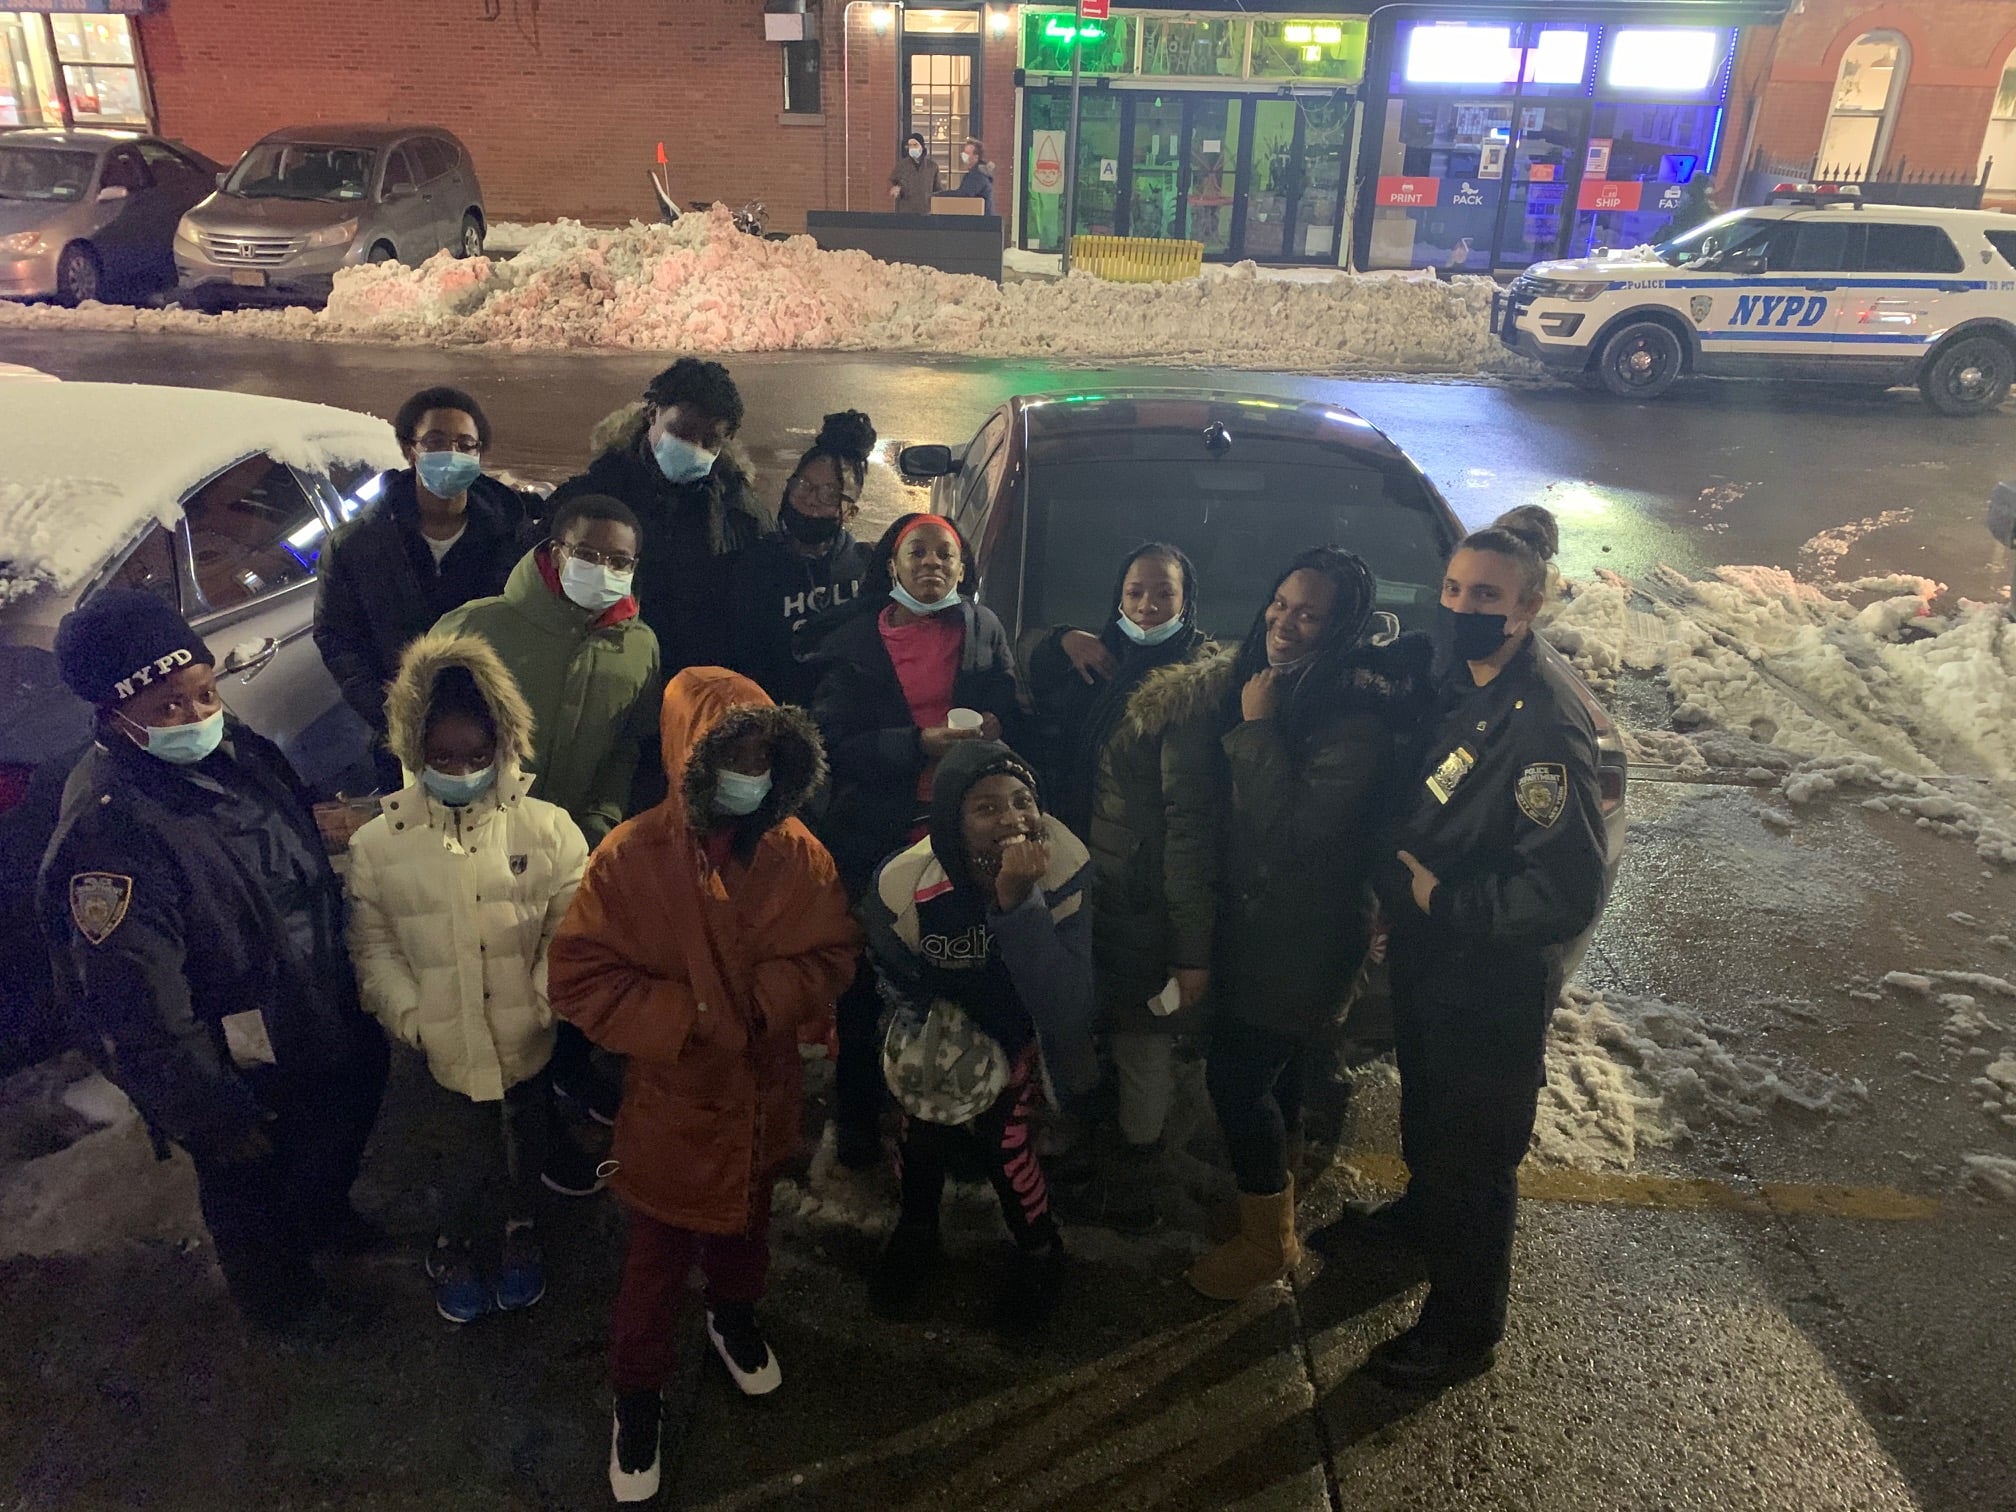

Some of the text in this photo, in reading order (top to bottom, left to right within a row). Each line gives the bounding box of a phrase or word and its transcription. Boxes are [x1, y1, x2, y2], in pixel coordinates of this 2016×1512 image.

[1103, 162, 1113, 175] A
[1390, 193, 1423, 203] PRINT
[1452, 195, 1484, 205] PACK
[1595, 198, 1621, 208] SHIP
[1627, 280, 1665, 290] POLICE
[1727, 295, 1827, 326] NYPD
[114, 648, 192, 699] NYPD
[1524, 767, 1549, 777] POLICE
[920, 924, 996, 960] adi
